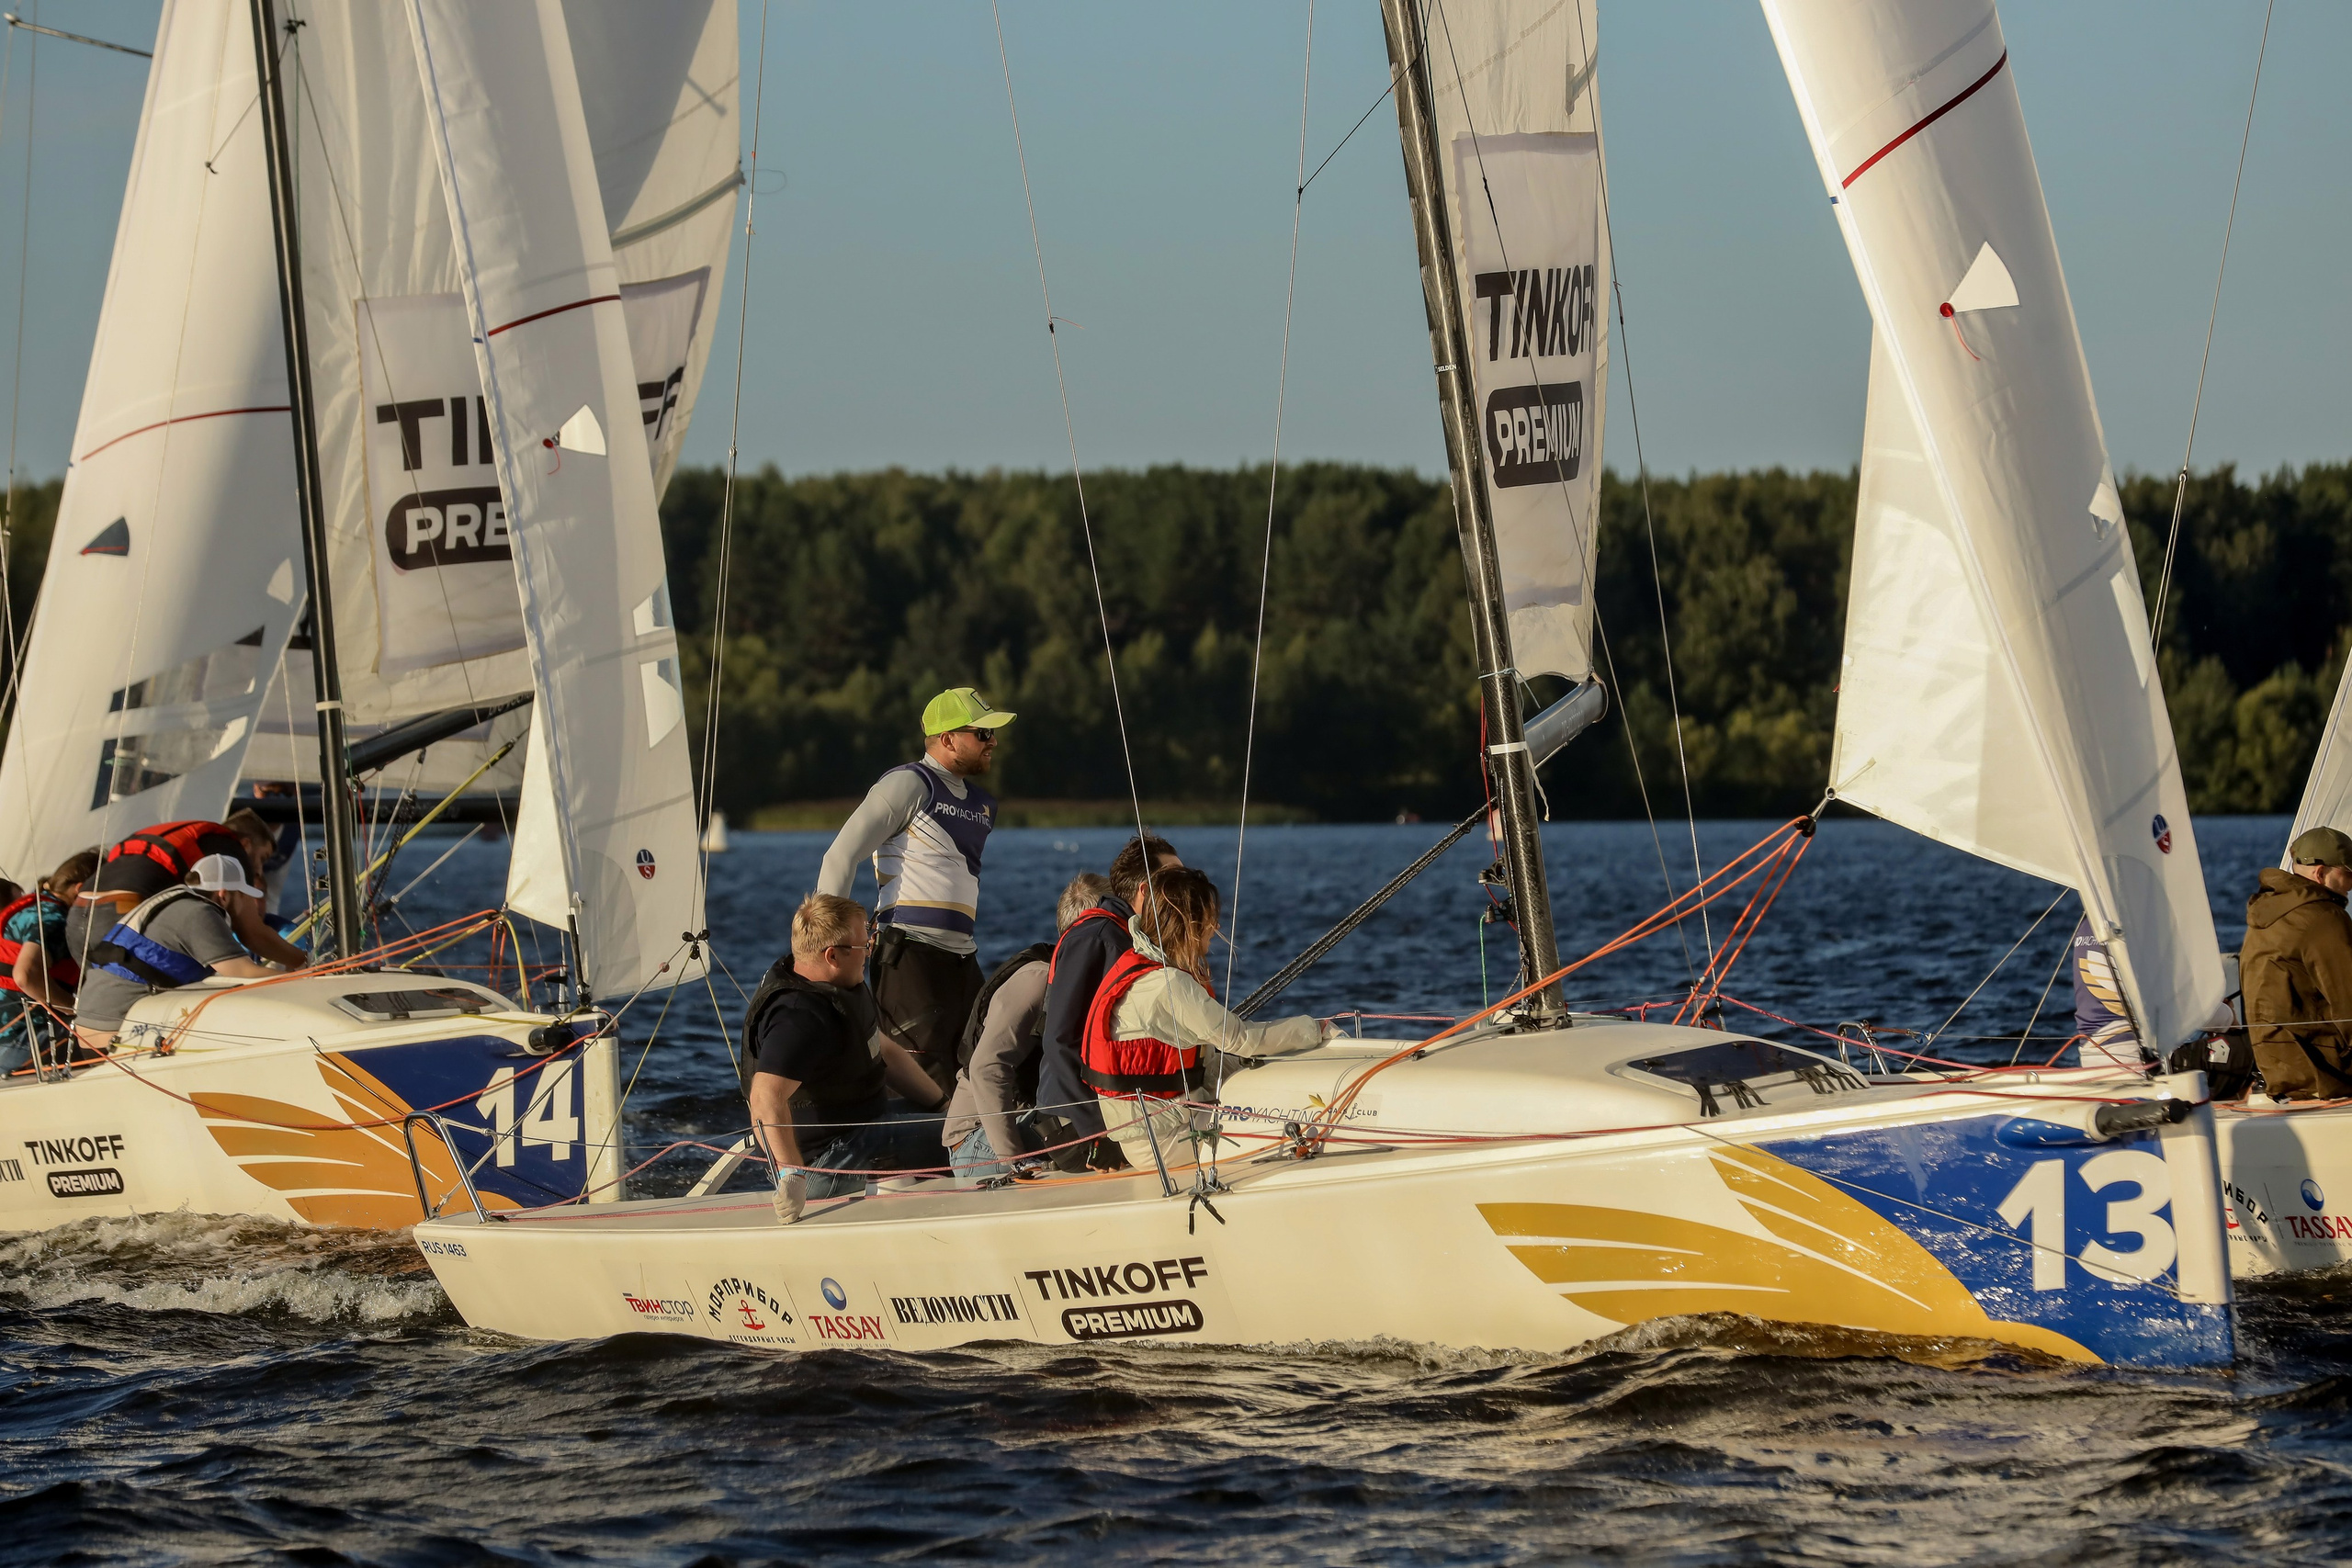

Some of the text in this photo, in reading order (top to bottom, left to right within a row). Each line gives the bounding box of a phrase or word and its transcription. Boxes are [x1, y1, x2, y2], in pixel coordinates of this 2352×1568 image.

[1493, 401, 1580, 467] PREMIUM
[476, 1059, 579, 1168] 14
[1356, 1109, 1378, 1117] CLUB
[25, 1134, 125, 1165] TINKOFF
[0, 1159, 25, 1182] СТИ
[50, 1172, 121, 1194] PREMIUM
[1996, 1150, 2178, 1292] 13
[421, 1240, 467, 1257] RUS 1463
[1024, 1256, 1209, 1301] TINKOFF
[708, 1277, 794, 1325] МОРПРИБОР
[890, 1293, 1020, 1327] ВЕДОМОСТИ
[808, 1315, 886, 1340] TASSAY
[1068, 1304, 1196, 1336] PREMIUM
[775, 1337, 797, 1345] ЧАСЫ
